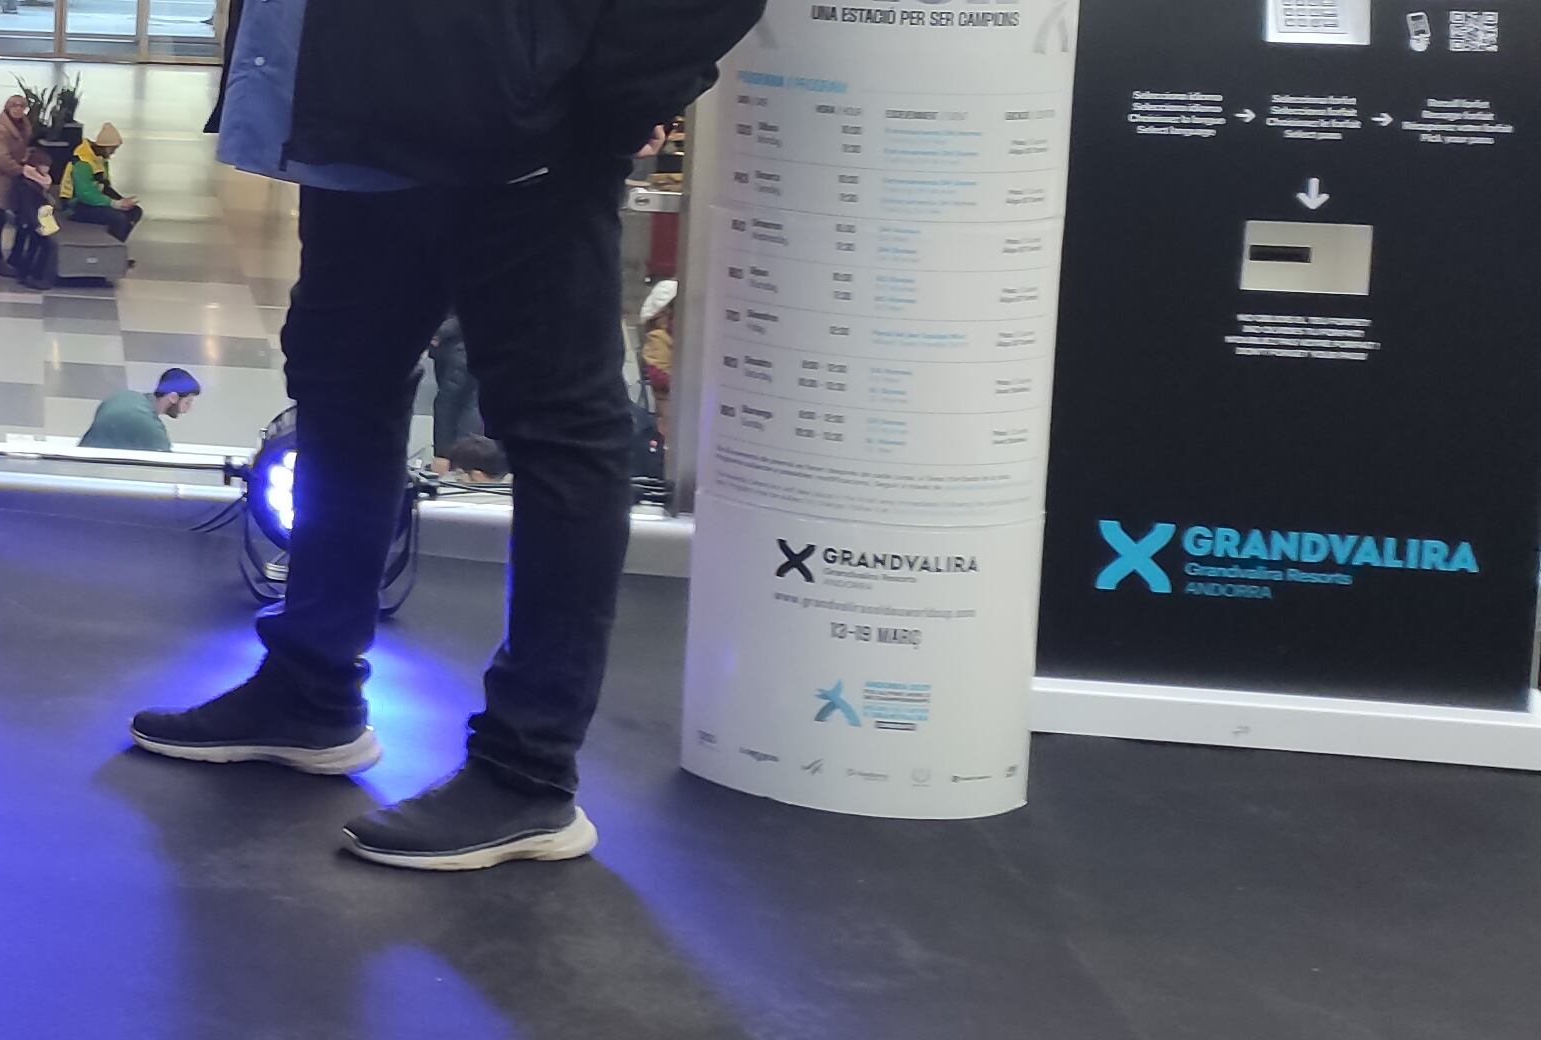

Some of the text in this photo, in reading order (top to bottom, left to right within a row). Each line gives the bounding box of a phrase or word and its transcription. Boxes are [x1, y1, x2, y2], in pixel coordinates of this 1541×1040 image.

[900, 9, 925, 27] PER
[930, 10, 954, 27] SER
[1182, 525, 1479, 573] GRANDVALIRA
[822, 547, 980, 573] GRANDVALIRA
[1185, 562, 1283, 582] Grandvalira
[1184, 584, 1273, 600] ANDORRA
